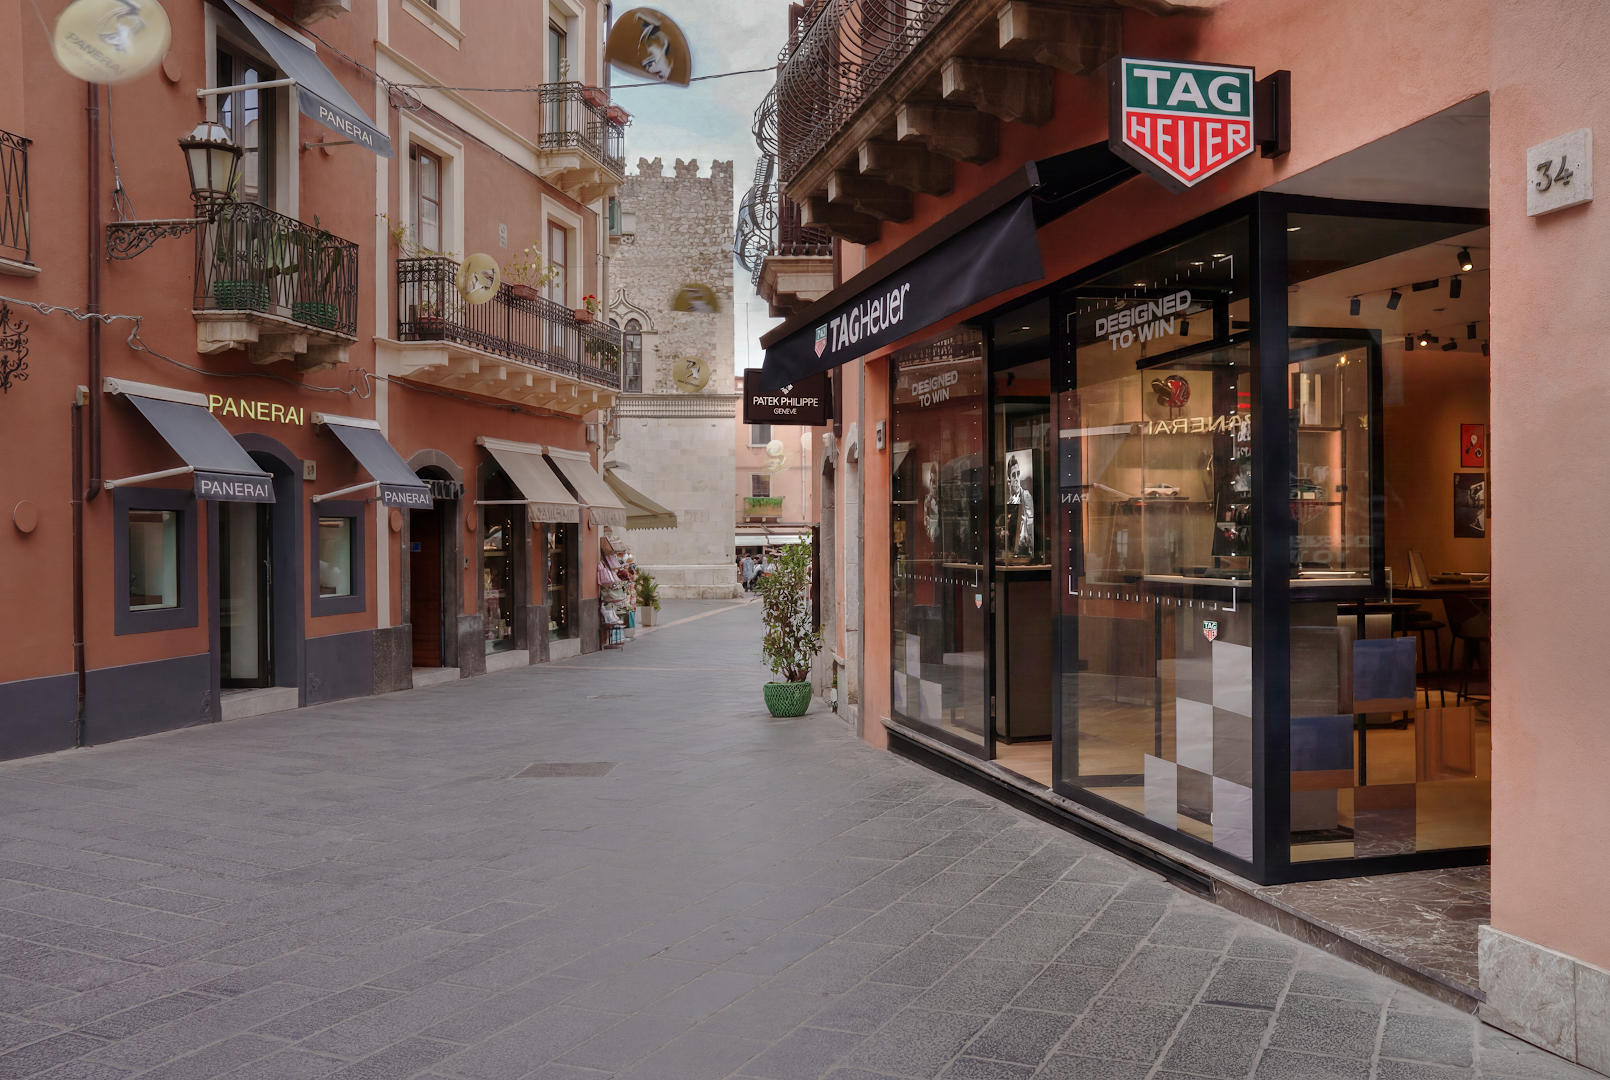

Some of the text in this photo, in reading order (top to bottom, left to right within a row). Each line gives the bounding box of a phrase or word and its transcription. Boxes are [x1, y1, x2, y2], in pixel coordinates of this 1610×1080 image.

[65, 31, 126, 76] PANERAI
[1133, 68, 1241, 112] TAG
[319, 105, 373, 146] PANERAI
[1131, 116, 1246, 177] HEUER
[1536, 155, 1574, 192] 34
[1095, 290, 1192, 338] DESIGNED
[1108, 316, 1175, 351] TO WIN
[911, 370, 958, 397] DESIGNED
[918, 387, 950, 408] TO WIN
[208, 394, 304, 426] PANERAI
[753, 396, 819, 407] PATEK PHILIPPE
[773, 407, 798, 415] GENEVE
[201, 480, 269, 498] PANERAI
[384, 491, 430, 505] PANERAI
[1203, 622, 1217, 630] TAG
